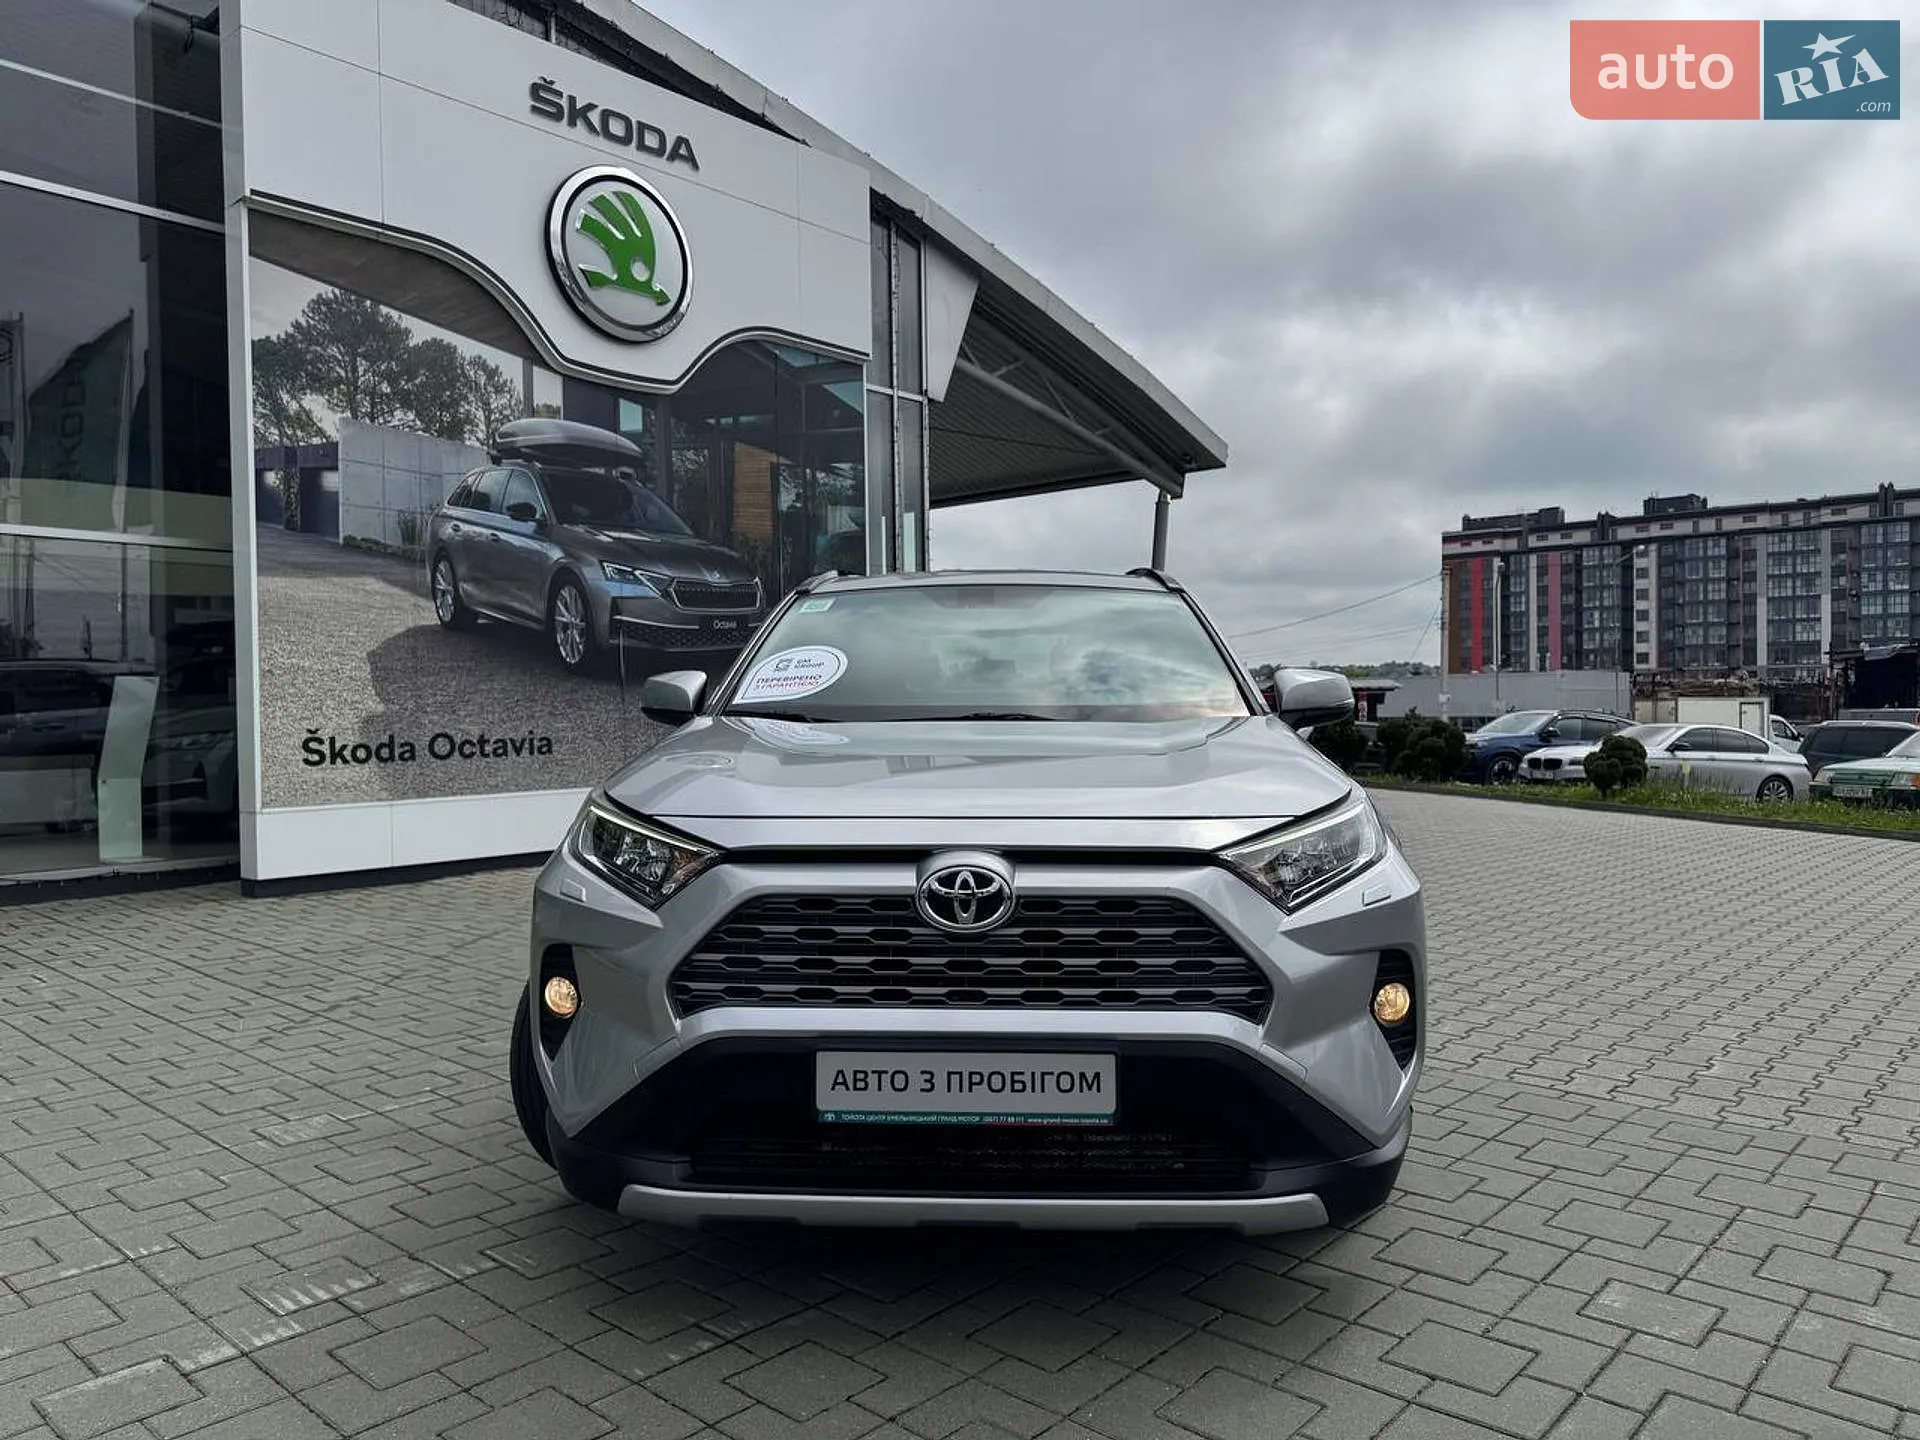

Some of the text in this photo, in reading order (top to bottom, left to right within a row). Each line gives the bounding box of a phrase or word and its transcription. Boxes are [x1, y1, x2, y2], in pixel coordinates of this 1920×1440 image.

[529, 75, 700, 172] ŠKODA
[302, 728, 553, 767] Škoda Octavia
[830, 1068, 910, 1093] АВТО
[946, 1070, 1102, 1094] ПРОБІГОМ
